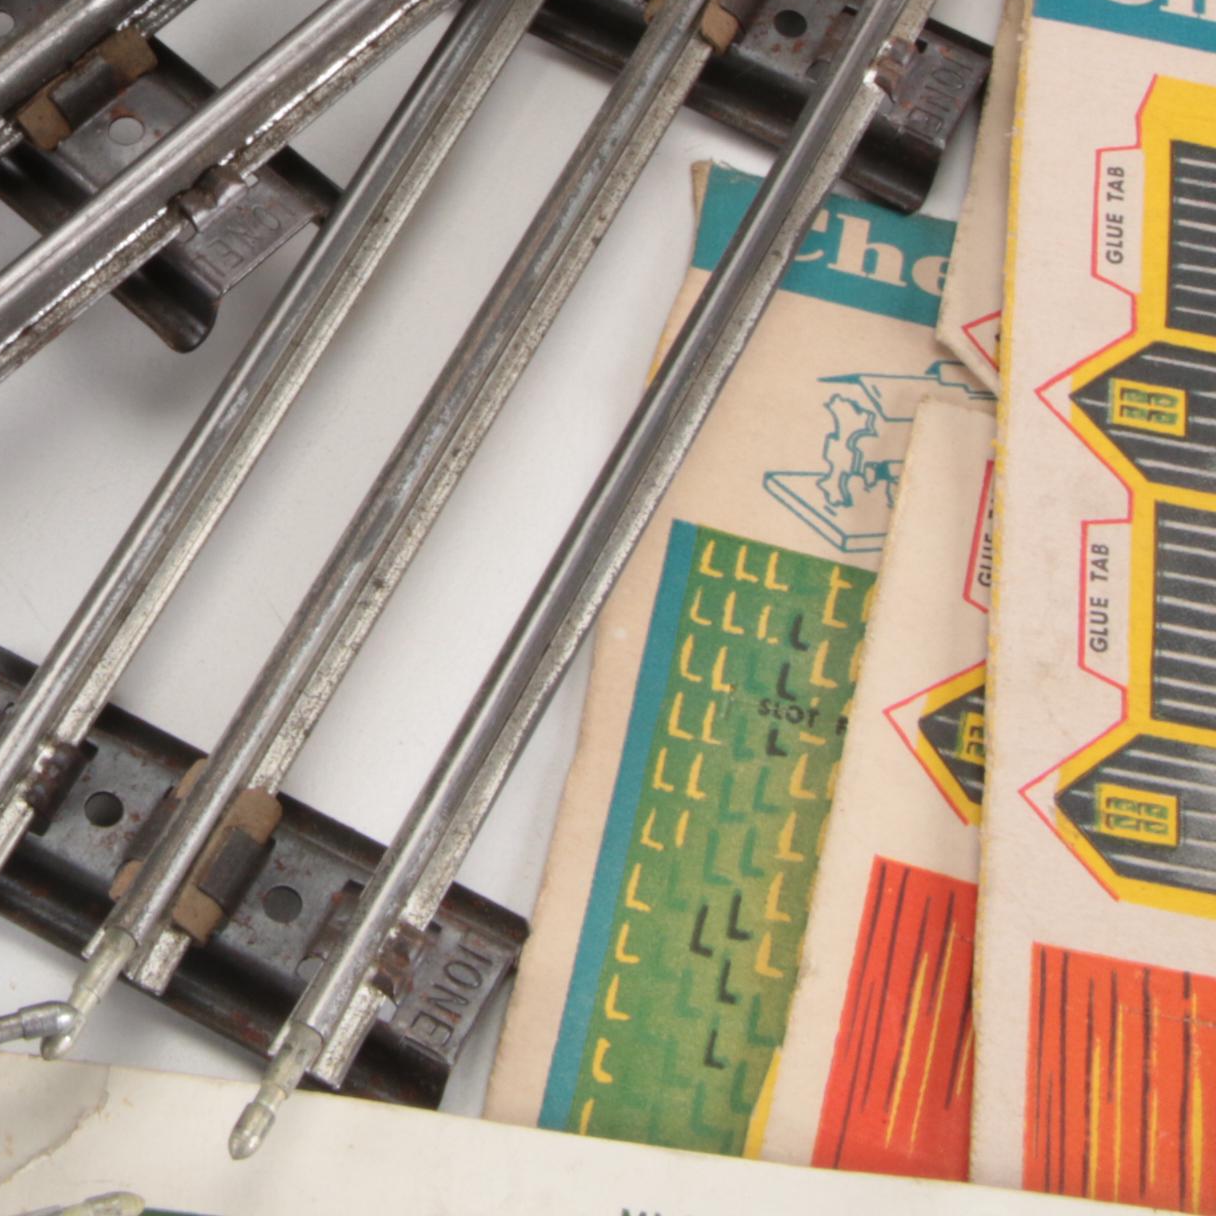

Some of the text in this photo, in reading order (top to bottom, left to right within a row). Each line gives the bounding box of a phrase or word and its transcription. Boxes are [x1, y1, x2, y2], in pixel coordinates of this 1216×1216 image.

[1105, 166, 1125, 265] GLUE TAB
[1089, 544, 1110, 653] GLUE TAB
[758, 698, 820, 728] SLOT
